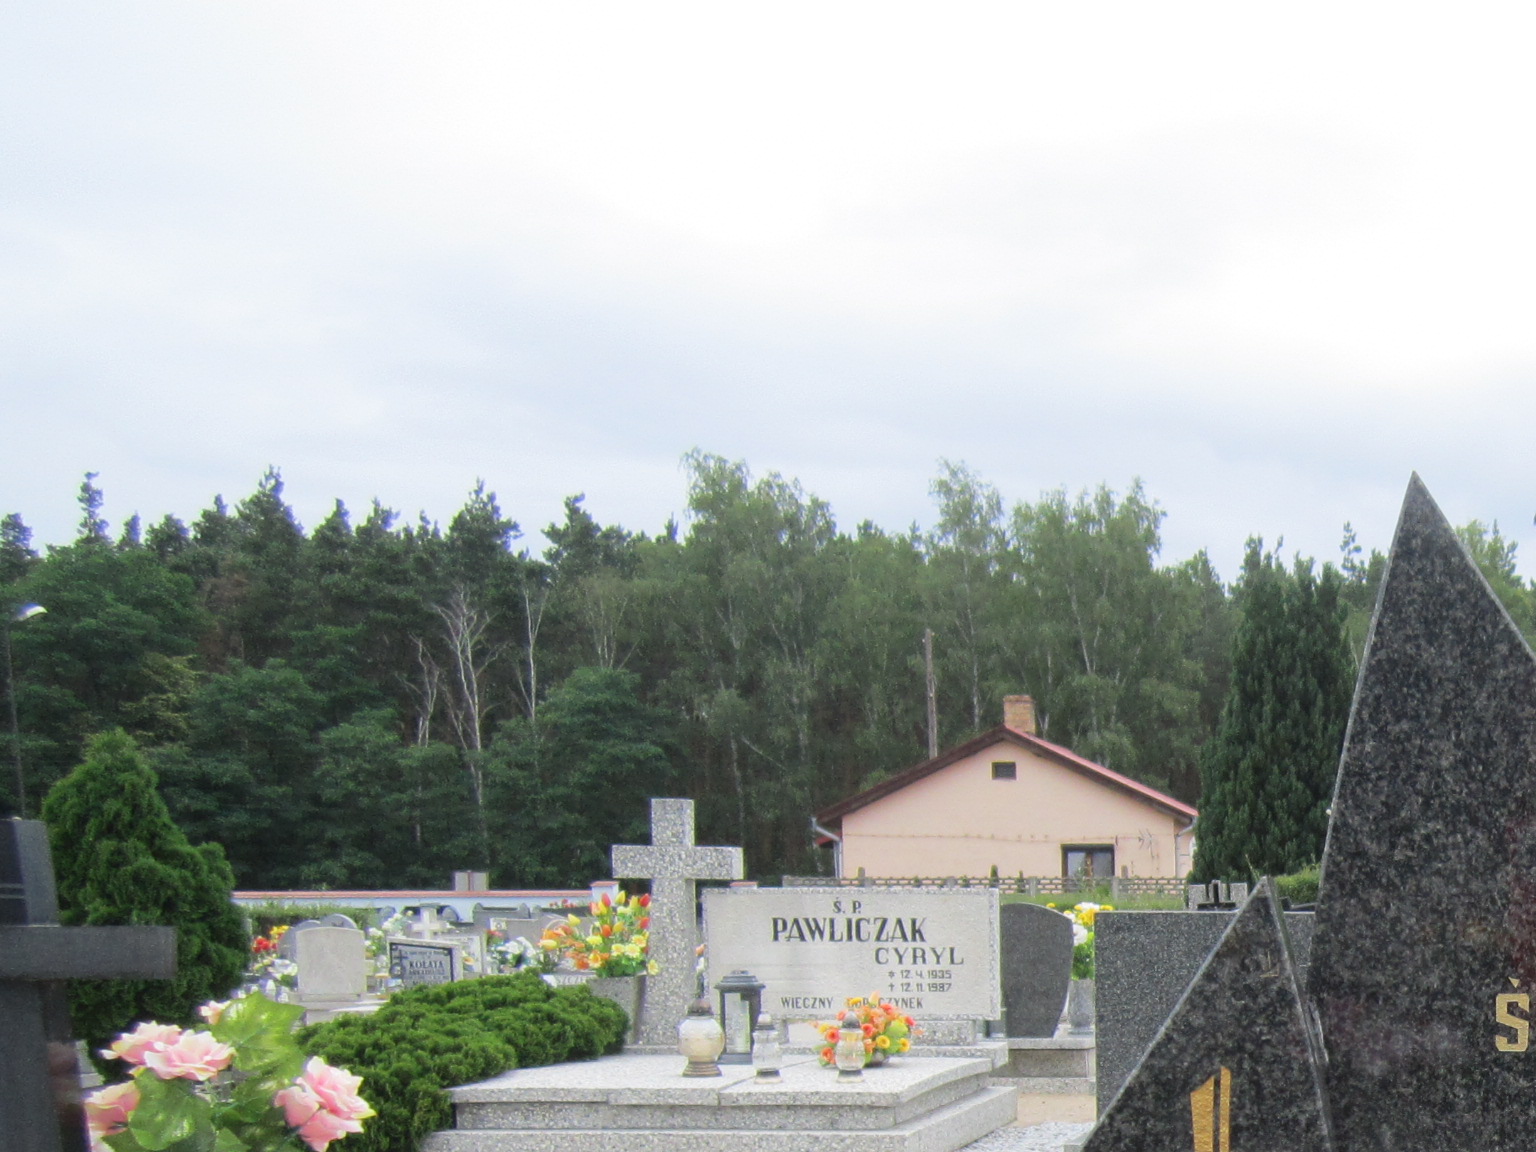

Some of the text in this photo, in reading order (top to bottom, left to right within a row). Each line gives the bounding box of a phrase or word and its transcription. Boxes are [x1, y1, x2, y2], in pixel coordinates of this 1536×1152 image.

[771, 917, 927, 943] PAWLICZAK
[874, 946, 965, 966] CYRYL
[927, 969, 952, 979] 1935
[927, 982, 953, 992] 1987
[781, 996, 924, 1010] WIECZNY PCZYNEK
